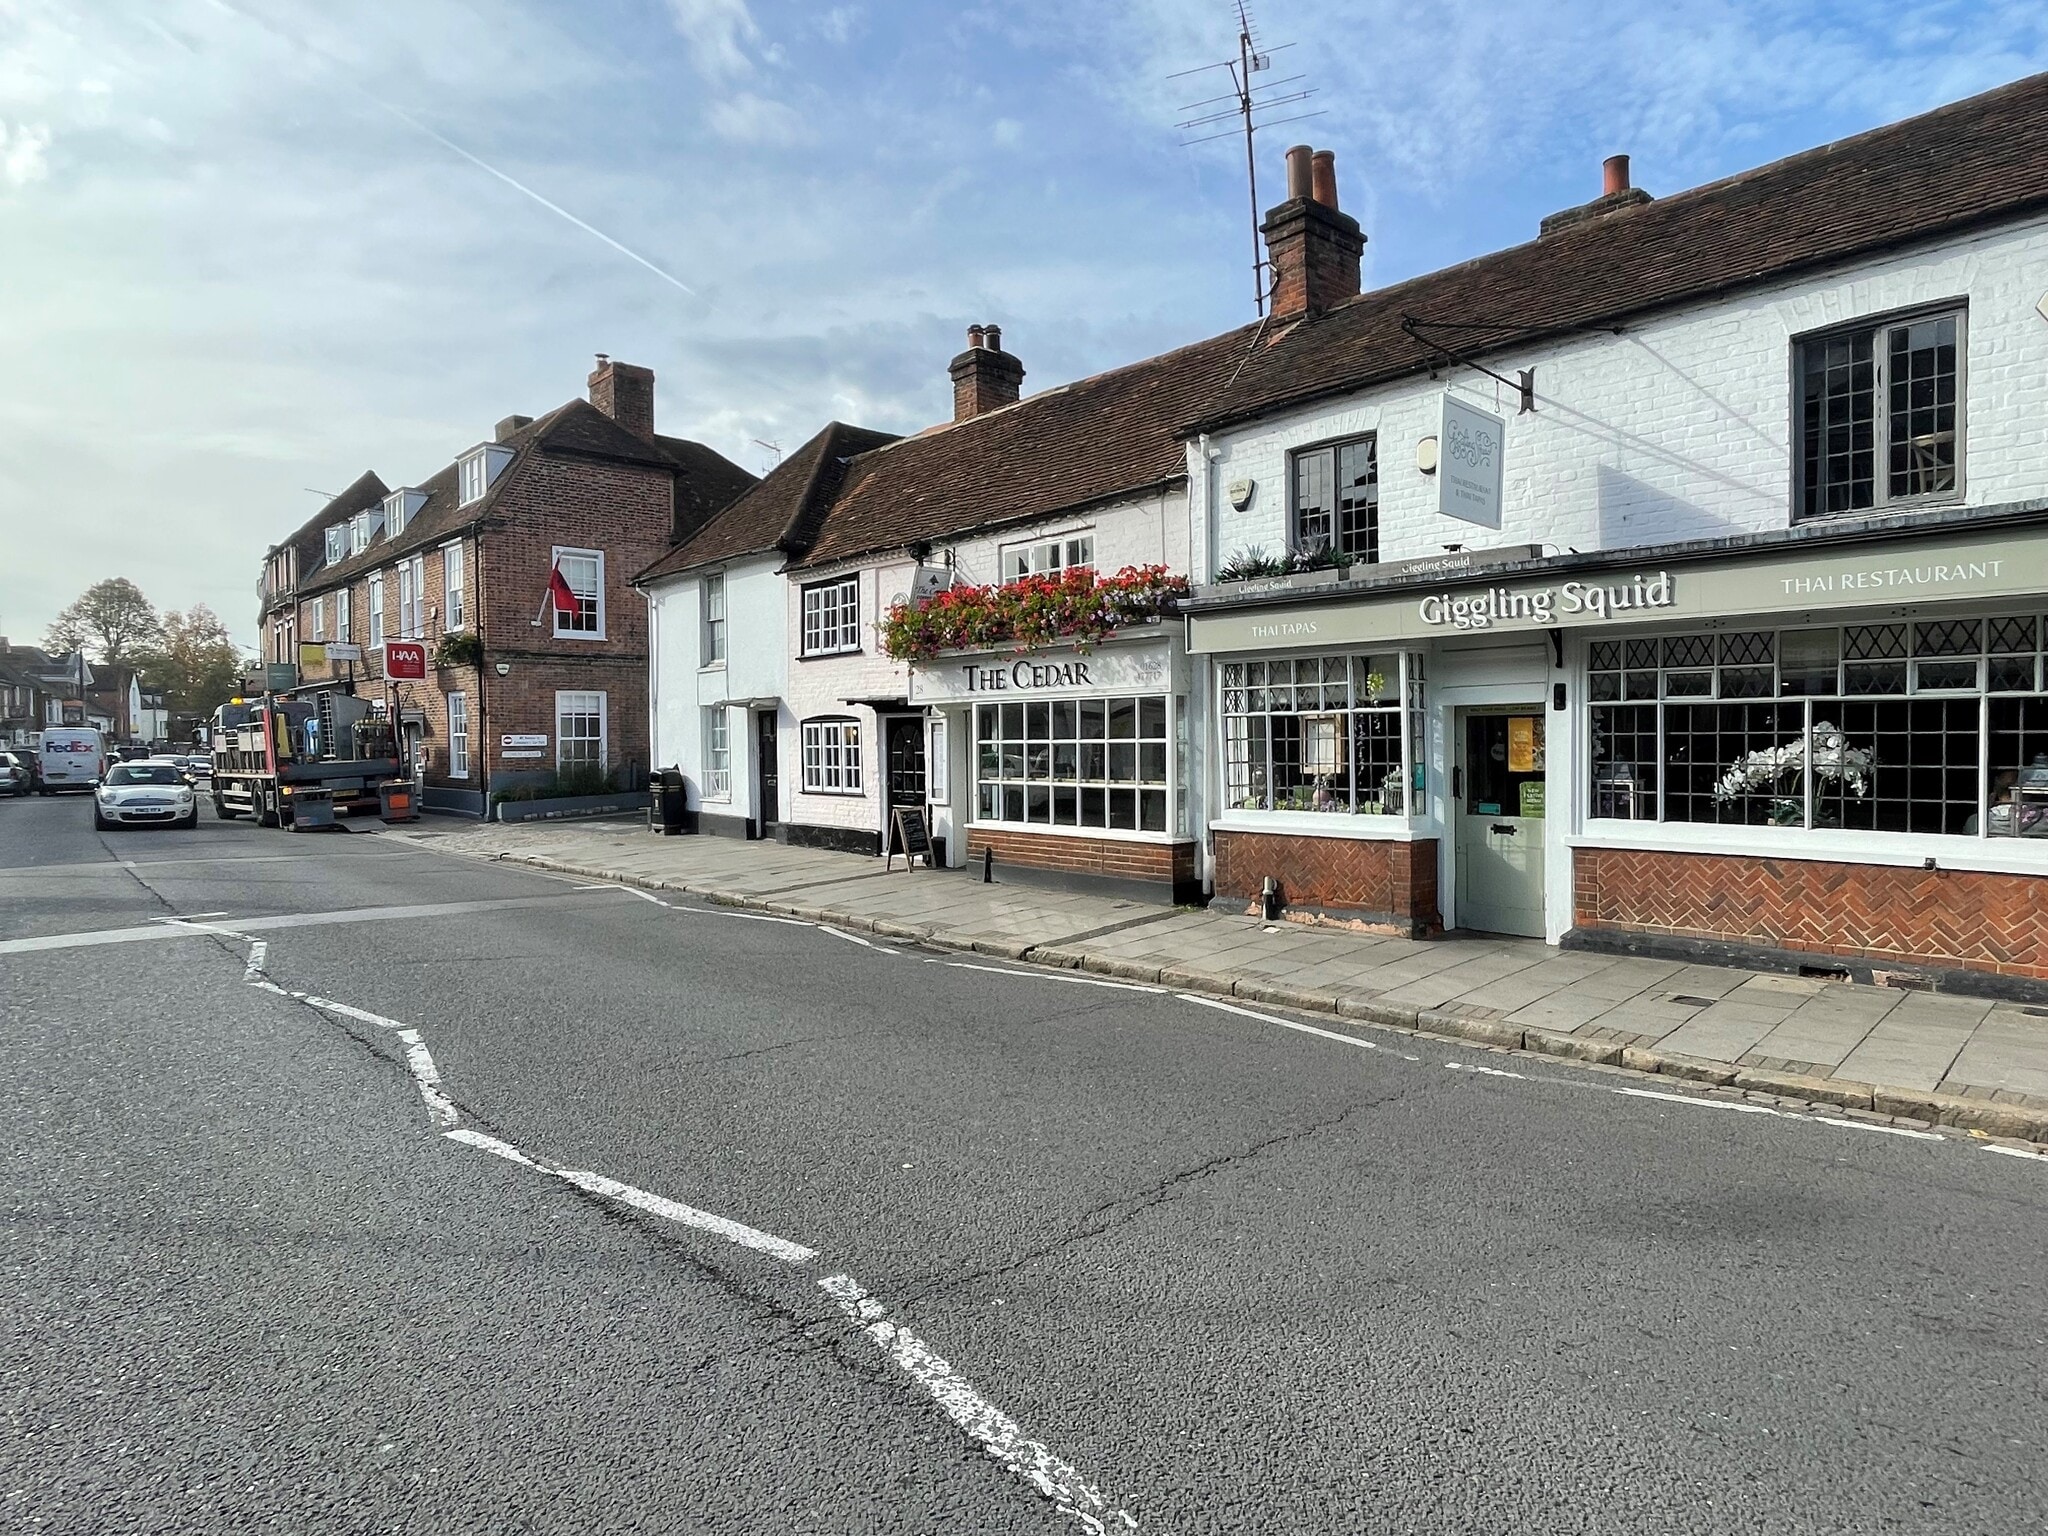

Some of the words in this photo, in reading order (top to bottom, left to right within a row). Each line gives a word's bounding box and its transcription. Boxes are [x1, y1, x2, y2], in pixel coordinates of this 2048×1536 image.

[1401, 560, 1440, 574] Giggling
[1442, 556, 1471, 571] Squid
[1269, 579, 1293, 591] Squid
[1780, 575, 1833, 594] THAI
[1841, 560, 2004, 590] RESTAURANT
[1418, 587, 1553, 629] Giggling
[1561, 571, 1674, 618] Squid
[1252, 625, 1278, 637] THAI
[1281, 621, 1317, 635] TAPAS
[963, 665, 1007, 691] THE
[1012, 660, 1093, 690] CEDAR
[915, 684, 924, 695] 28
[45, 740, 94, 753] FedEx
